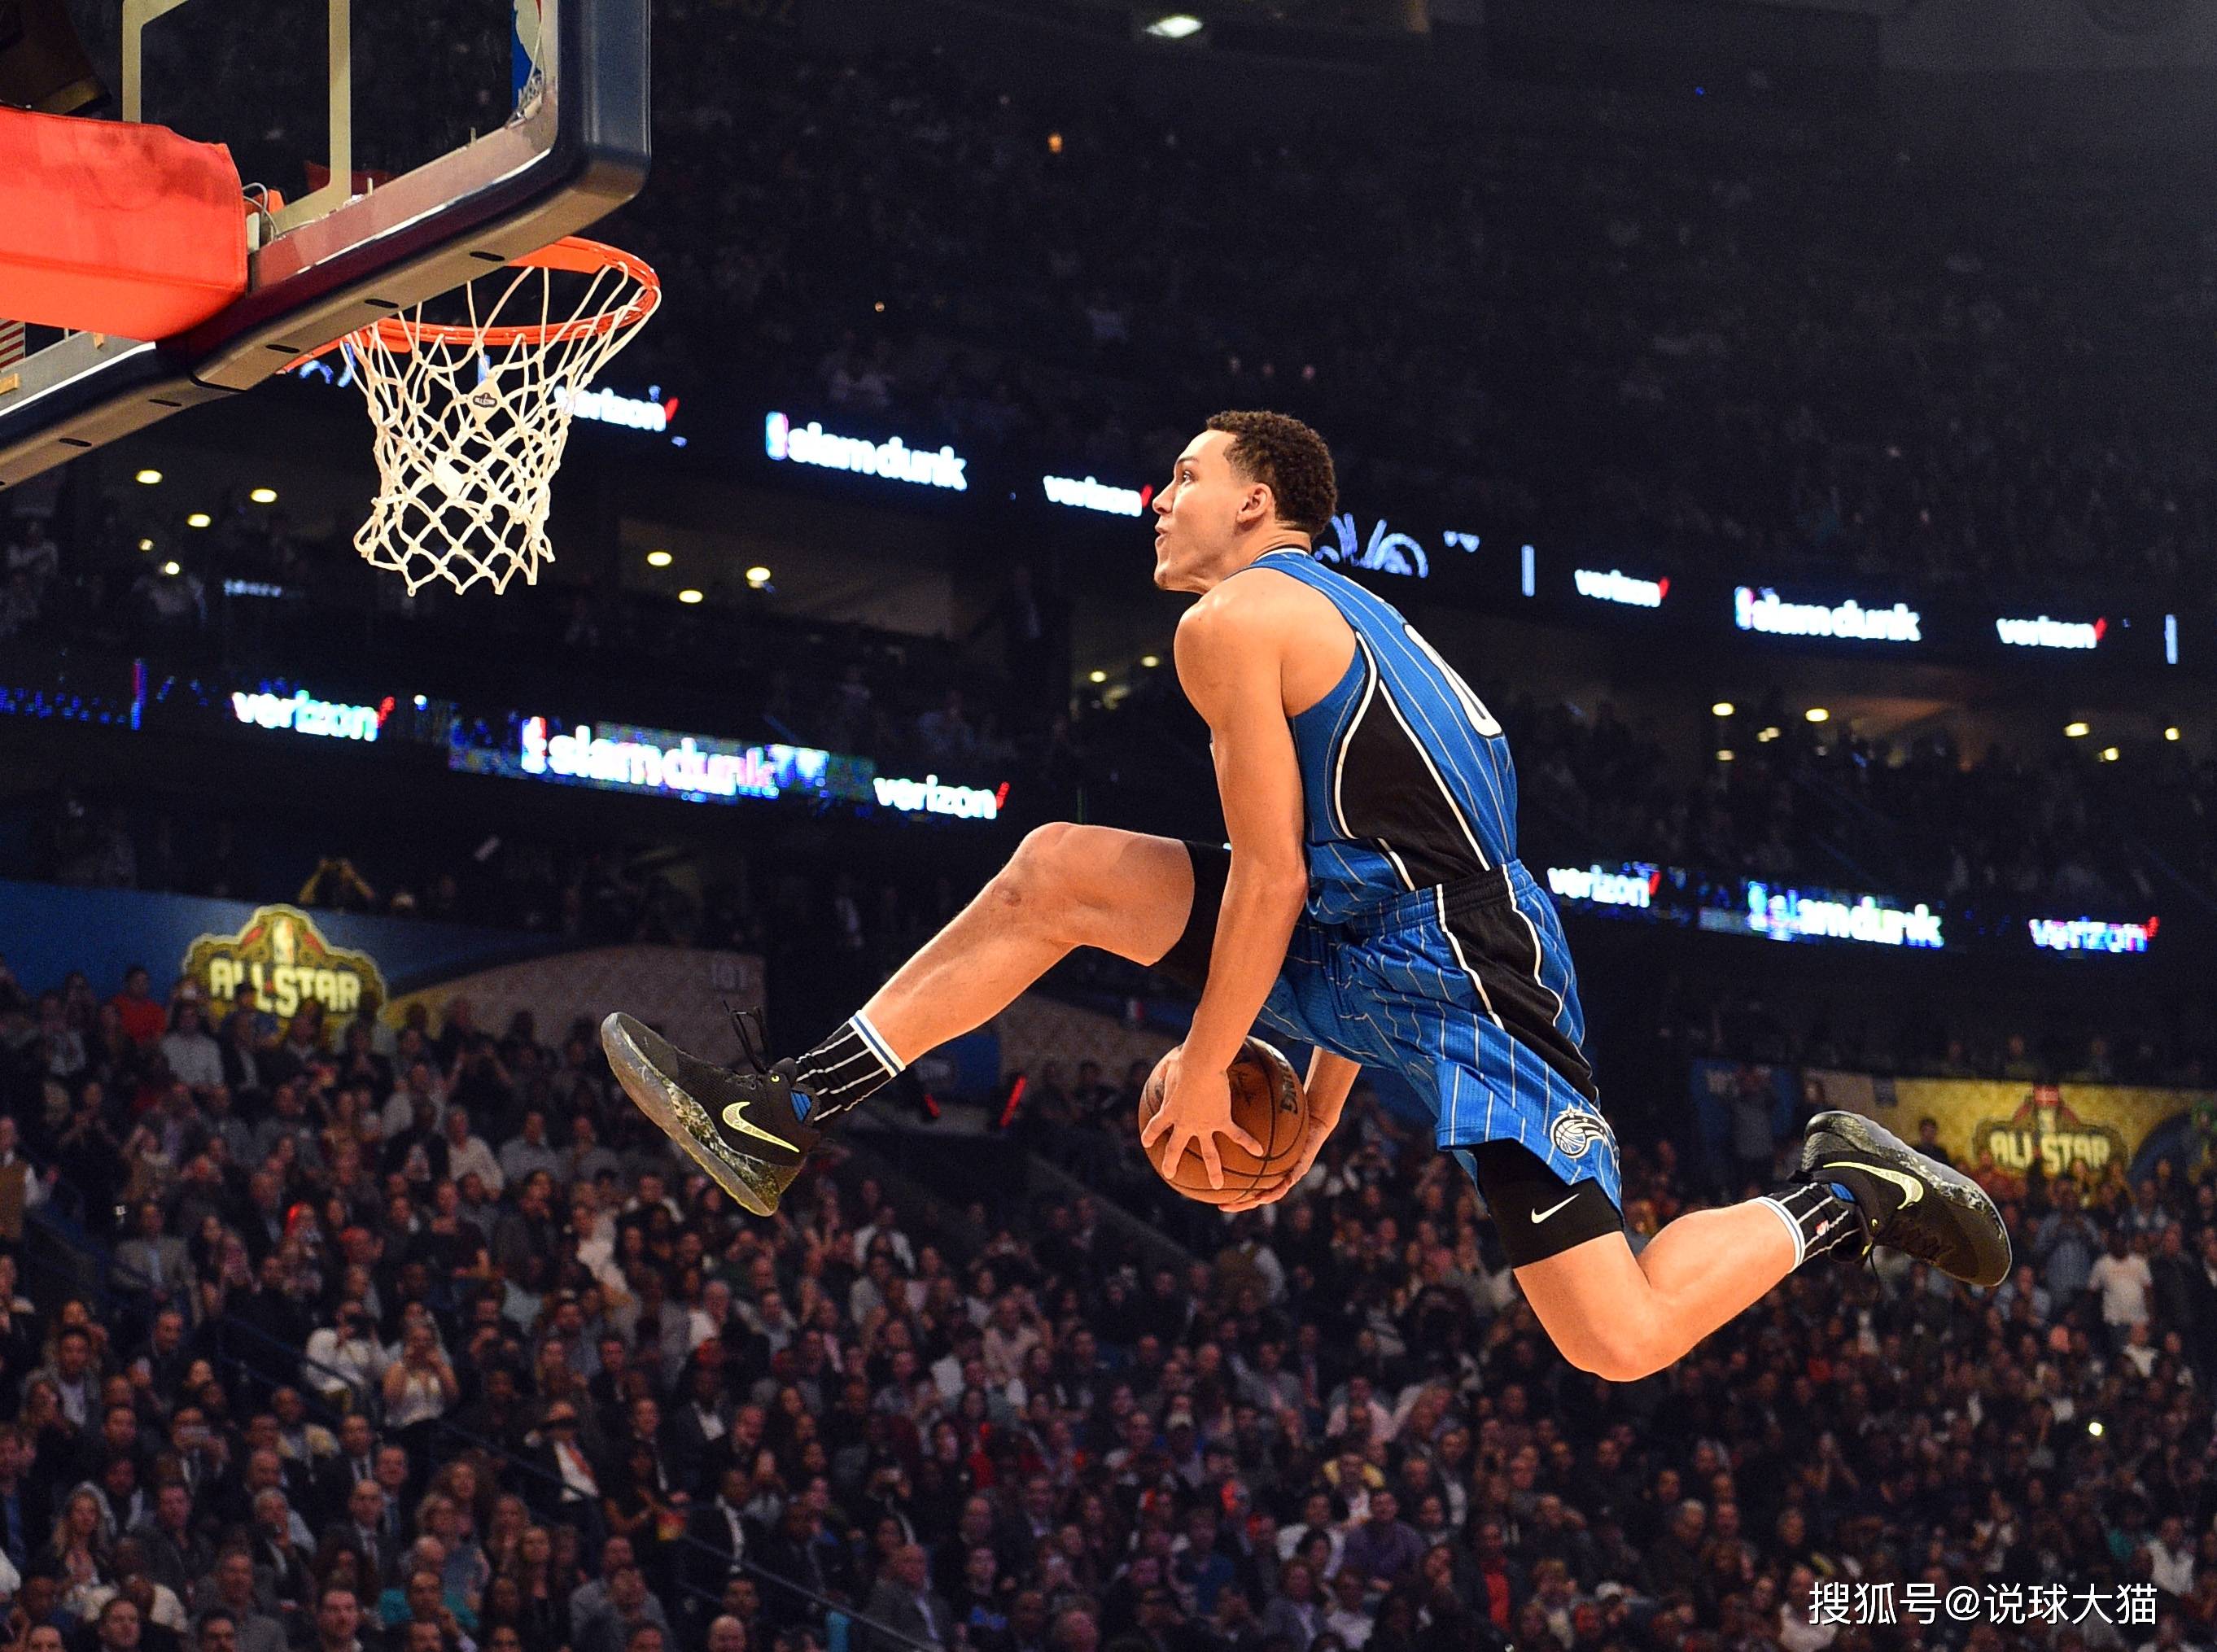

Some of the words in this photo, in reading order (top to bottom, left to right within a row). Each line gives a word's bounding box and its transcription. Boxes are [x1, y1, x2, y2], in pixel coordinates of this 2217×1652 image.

[1043, 476, 1143, 517] verizon
[232, 691, 379, 741] verizon
[873, 775, 996, 819] verizon
[1547, 865, 1650, 907] verizon
